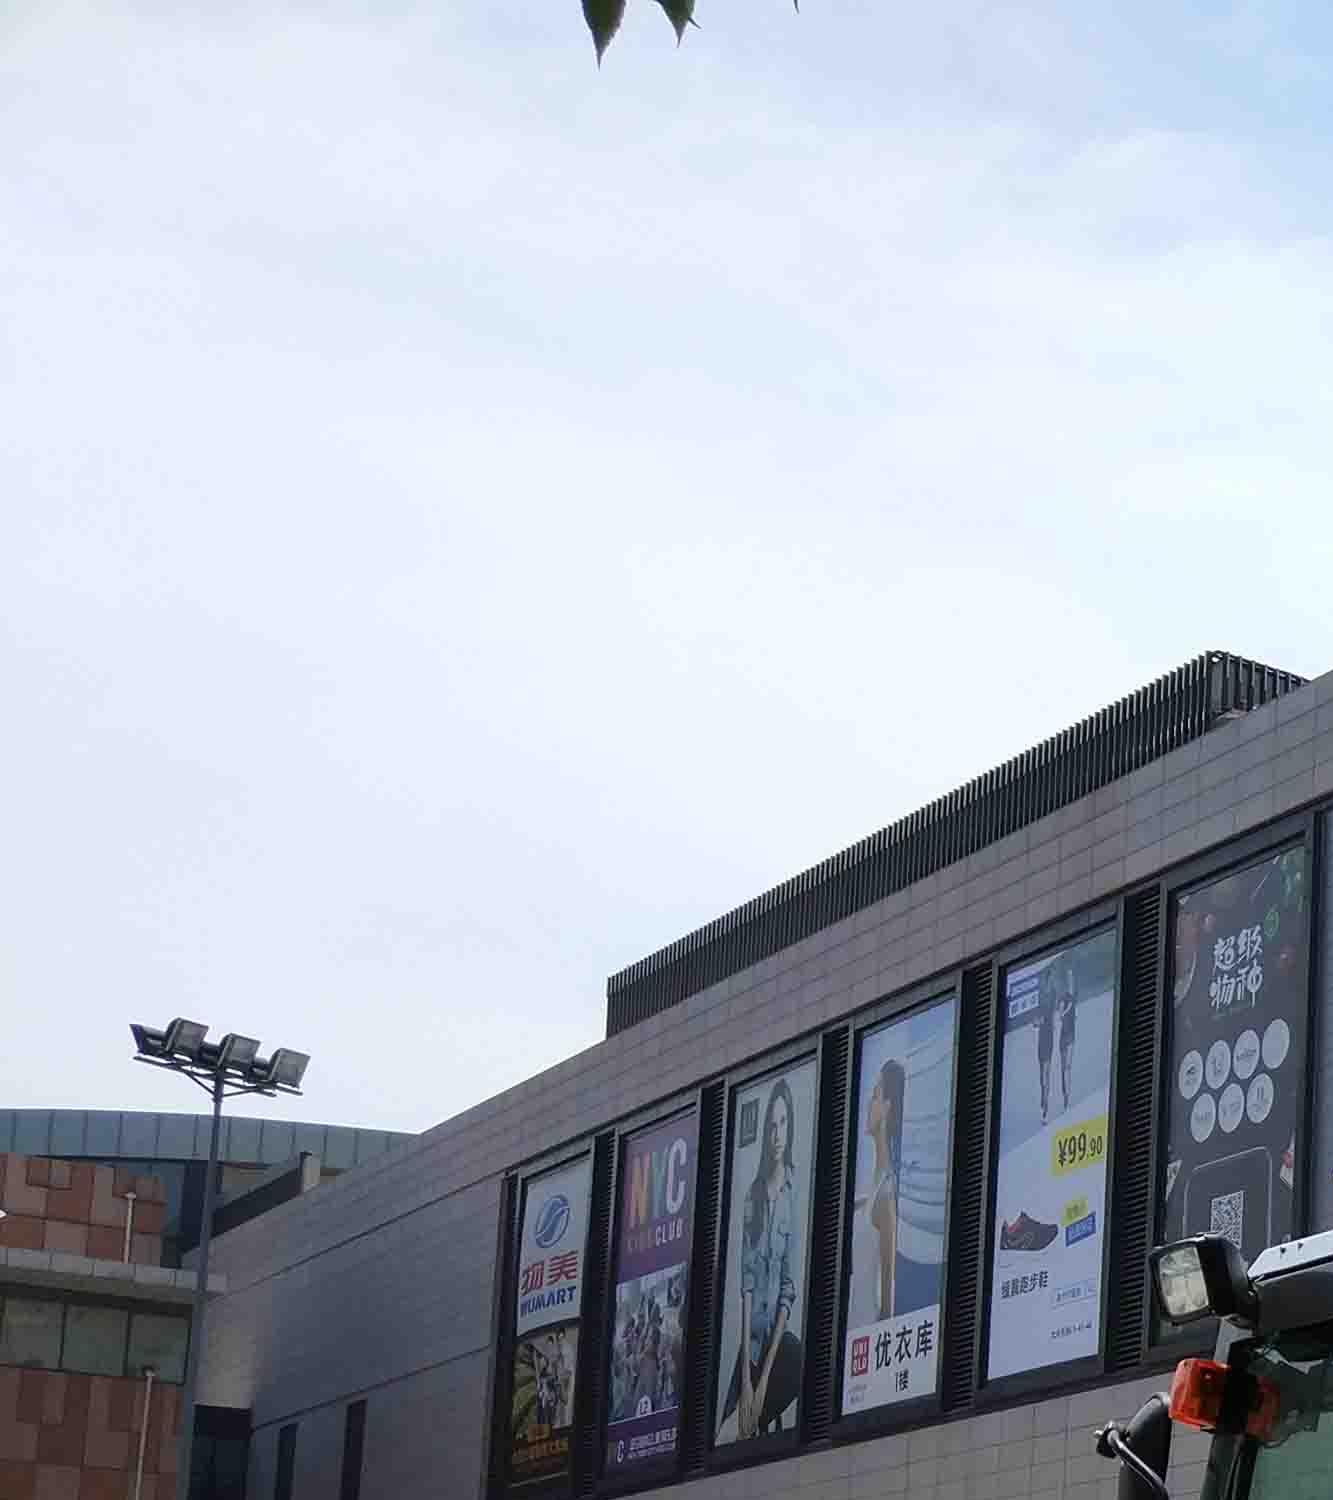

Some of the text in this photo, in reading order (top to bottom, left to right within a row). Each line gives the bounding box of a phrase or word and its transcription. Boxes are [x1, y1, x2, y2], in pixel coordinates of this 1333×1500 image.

[1058, 1132, 1103, 1167] ¥99.90
[520, 1249, 579, 1297] 物美
[520, 1285, 577, 1318] WUMART
[875, 1320, 934, 1371] 优衣库
